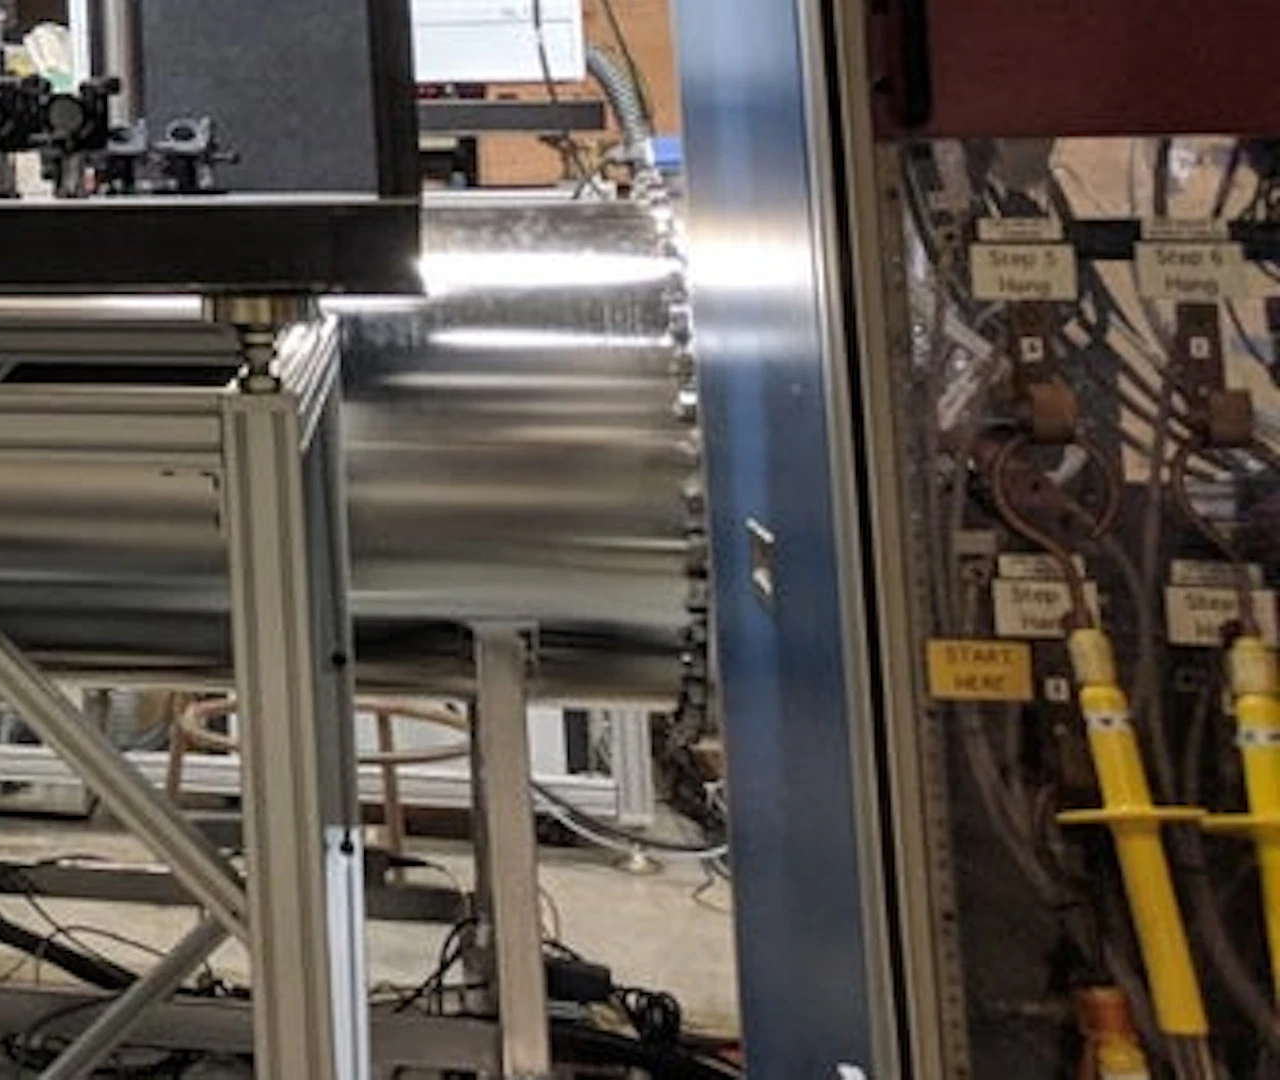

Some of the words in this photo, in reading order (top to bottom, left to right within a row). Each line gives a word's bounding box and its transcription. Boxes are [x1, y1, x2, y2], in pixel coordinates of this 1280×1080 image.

[988, 248, 1038, 268] Step
[1155, 247, 1202, 268] Step
[1011, 584, 1061, 606] Step
[945, 644, 1013, 666] START
[951, 674, 1006, 692] HERE
